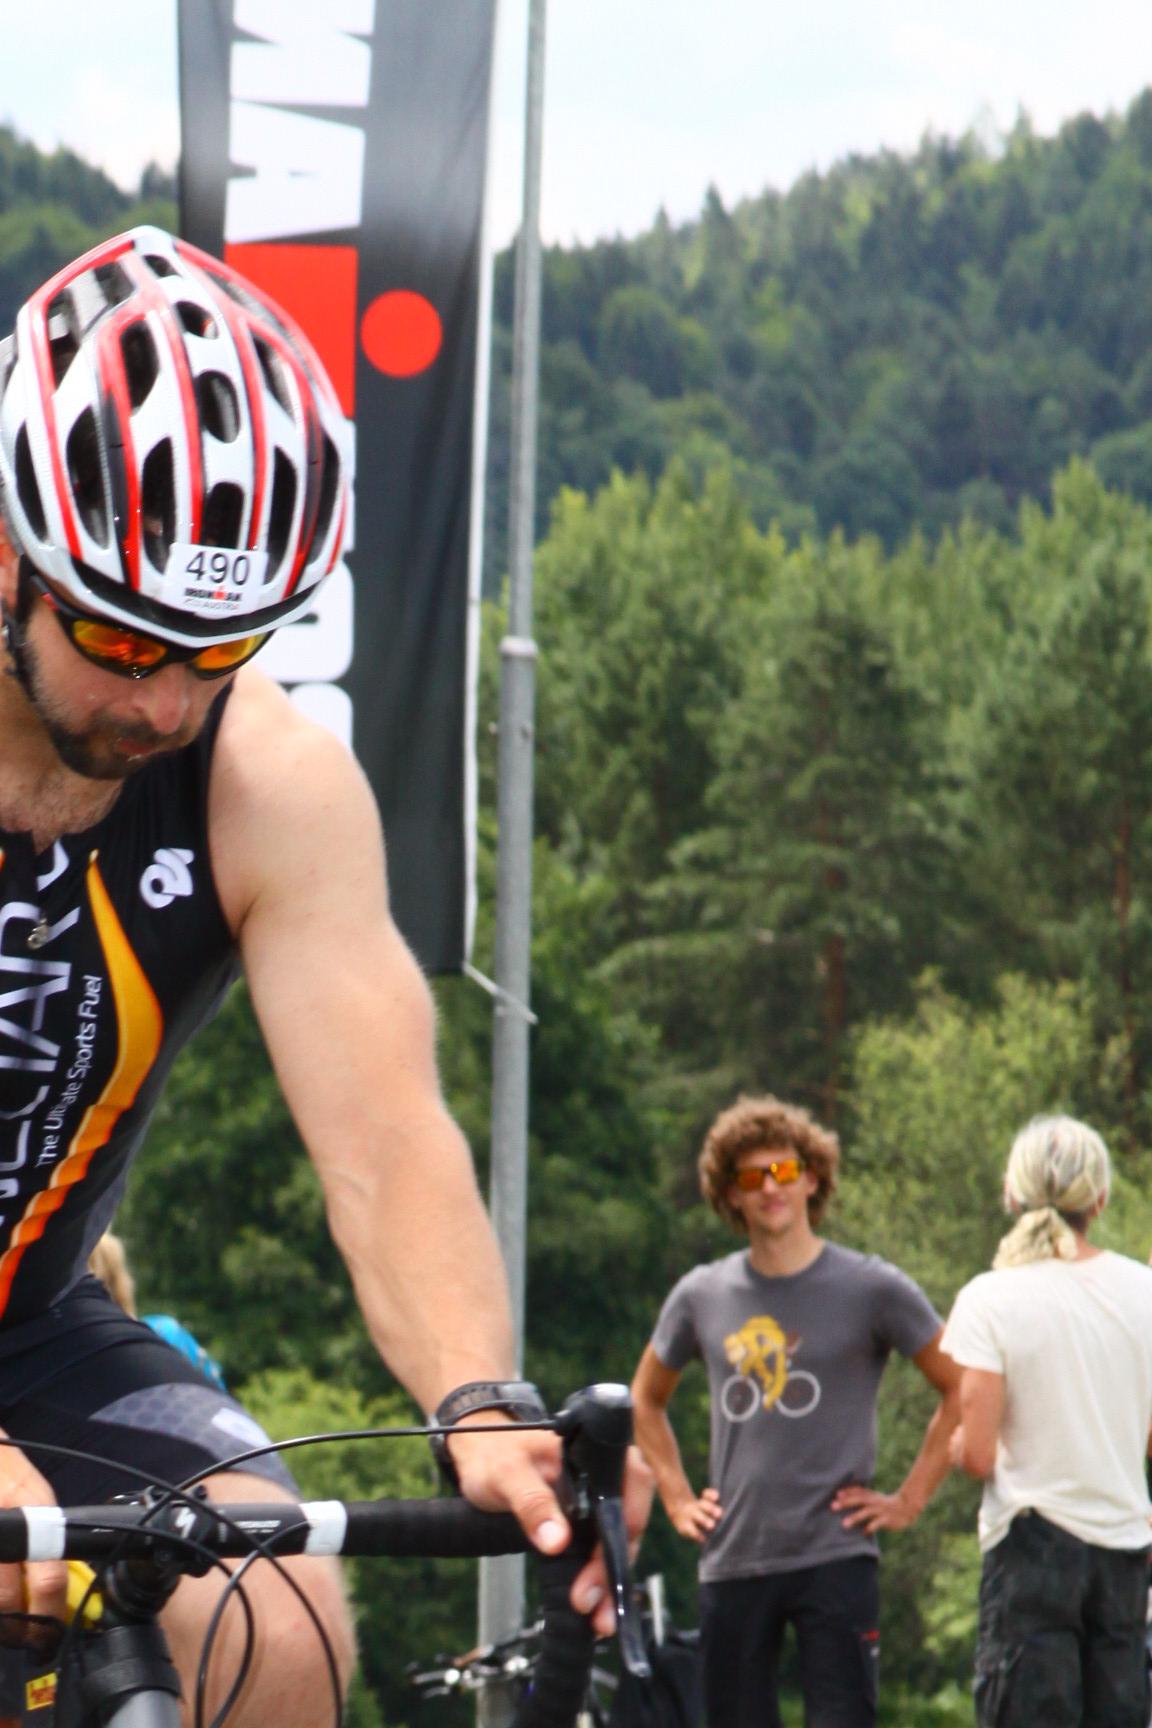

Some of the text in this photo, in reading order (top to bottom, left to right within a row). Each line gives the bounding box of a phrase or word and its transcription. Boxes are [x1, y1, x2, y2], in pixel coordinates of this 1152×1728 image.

[186, 551, 250, 586] 490
[79, 975, 103, 1019] Fuel
[66, 1021, 97, 1078] Sports
[35, 1134, 60, 1168] The
